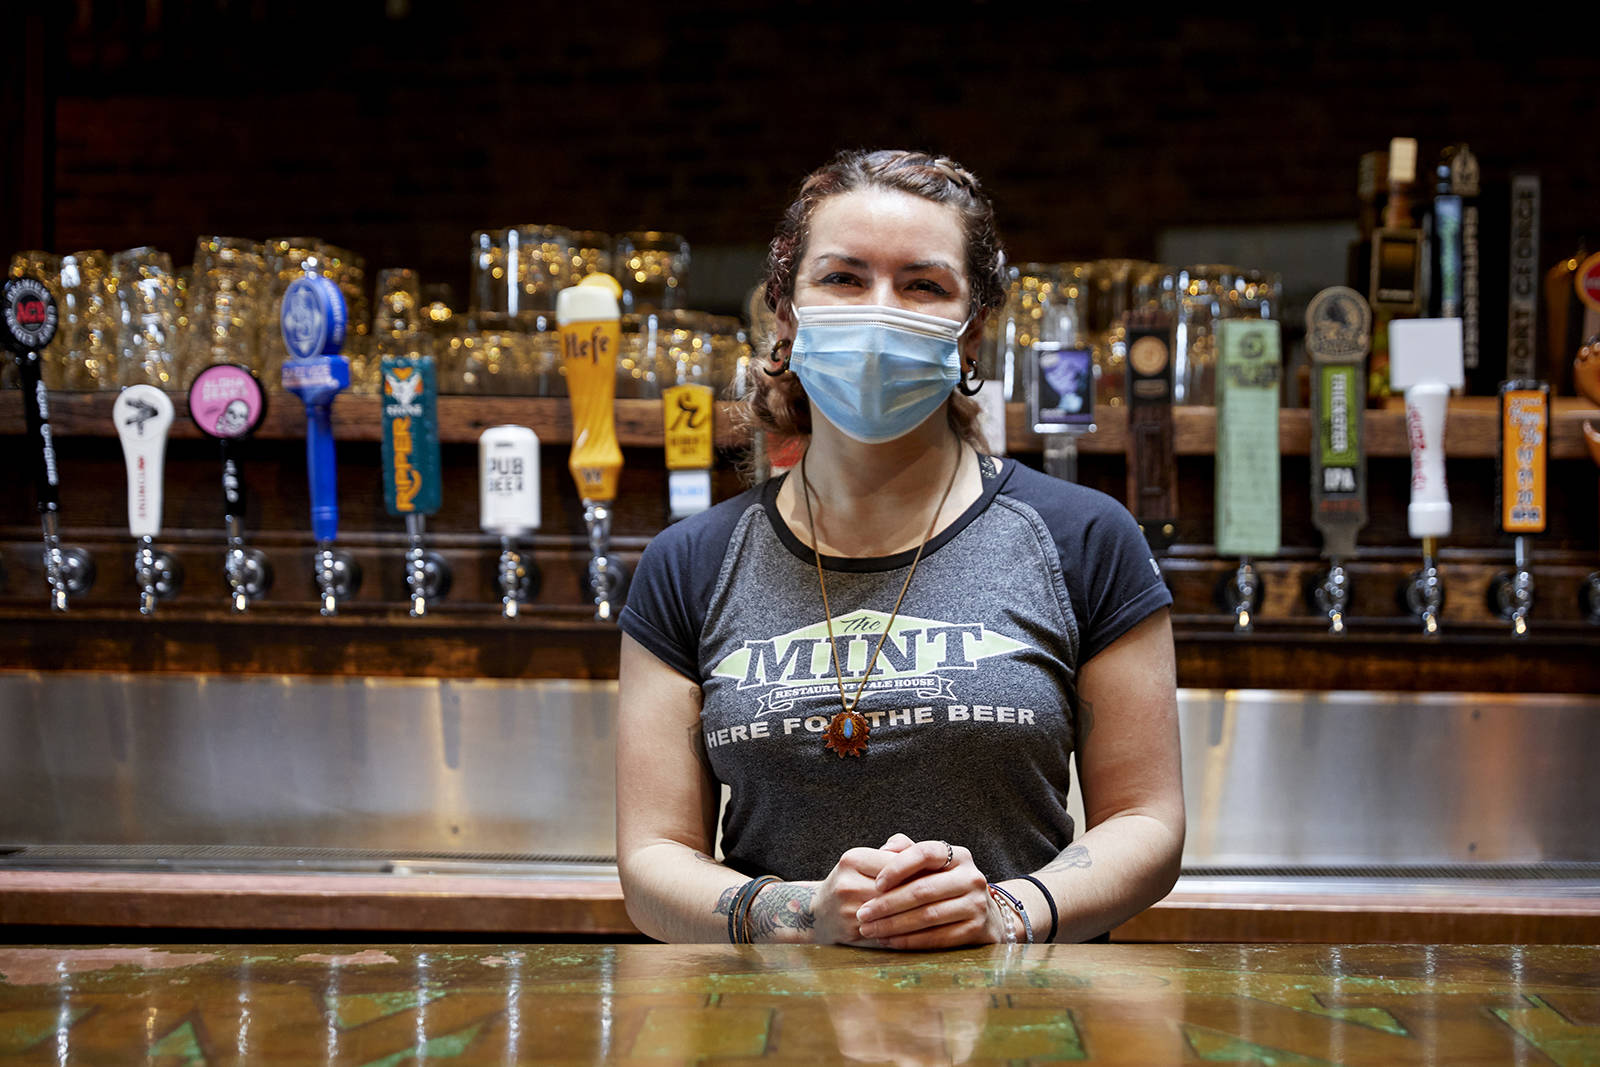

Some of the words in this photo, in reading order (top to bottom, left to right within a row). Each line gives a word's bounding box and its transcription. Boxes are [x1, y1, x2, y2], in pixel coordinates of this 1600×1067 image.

[564, 326, 611, 366] Hefe
[392, 415, 423, 512] RIPPER
[486, 457, 523, 476] PUB
[1324, 467, 1355, 492] IPA
[840, 616, 881, 633] The
[738, 624, 984, 688] MINT
[775, 683, 857, 699] RESTAURANT
[894, 678, 935, 687] HOUSE
[706, 721, 770, 749] HERE
[783, 715, 838, 735] FO
[864, 706, 934, 728] THE
[948, 704, 1035, 725] BEER
